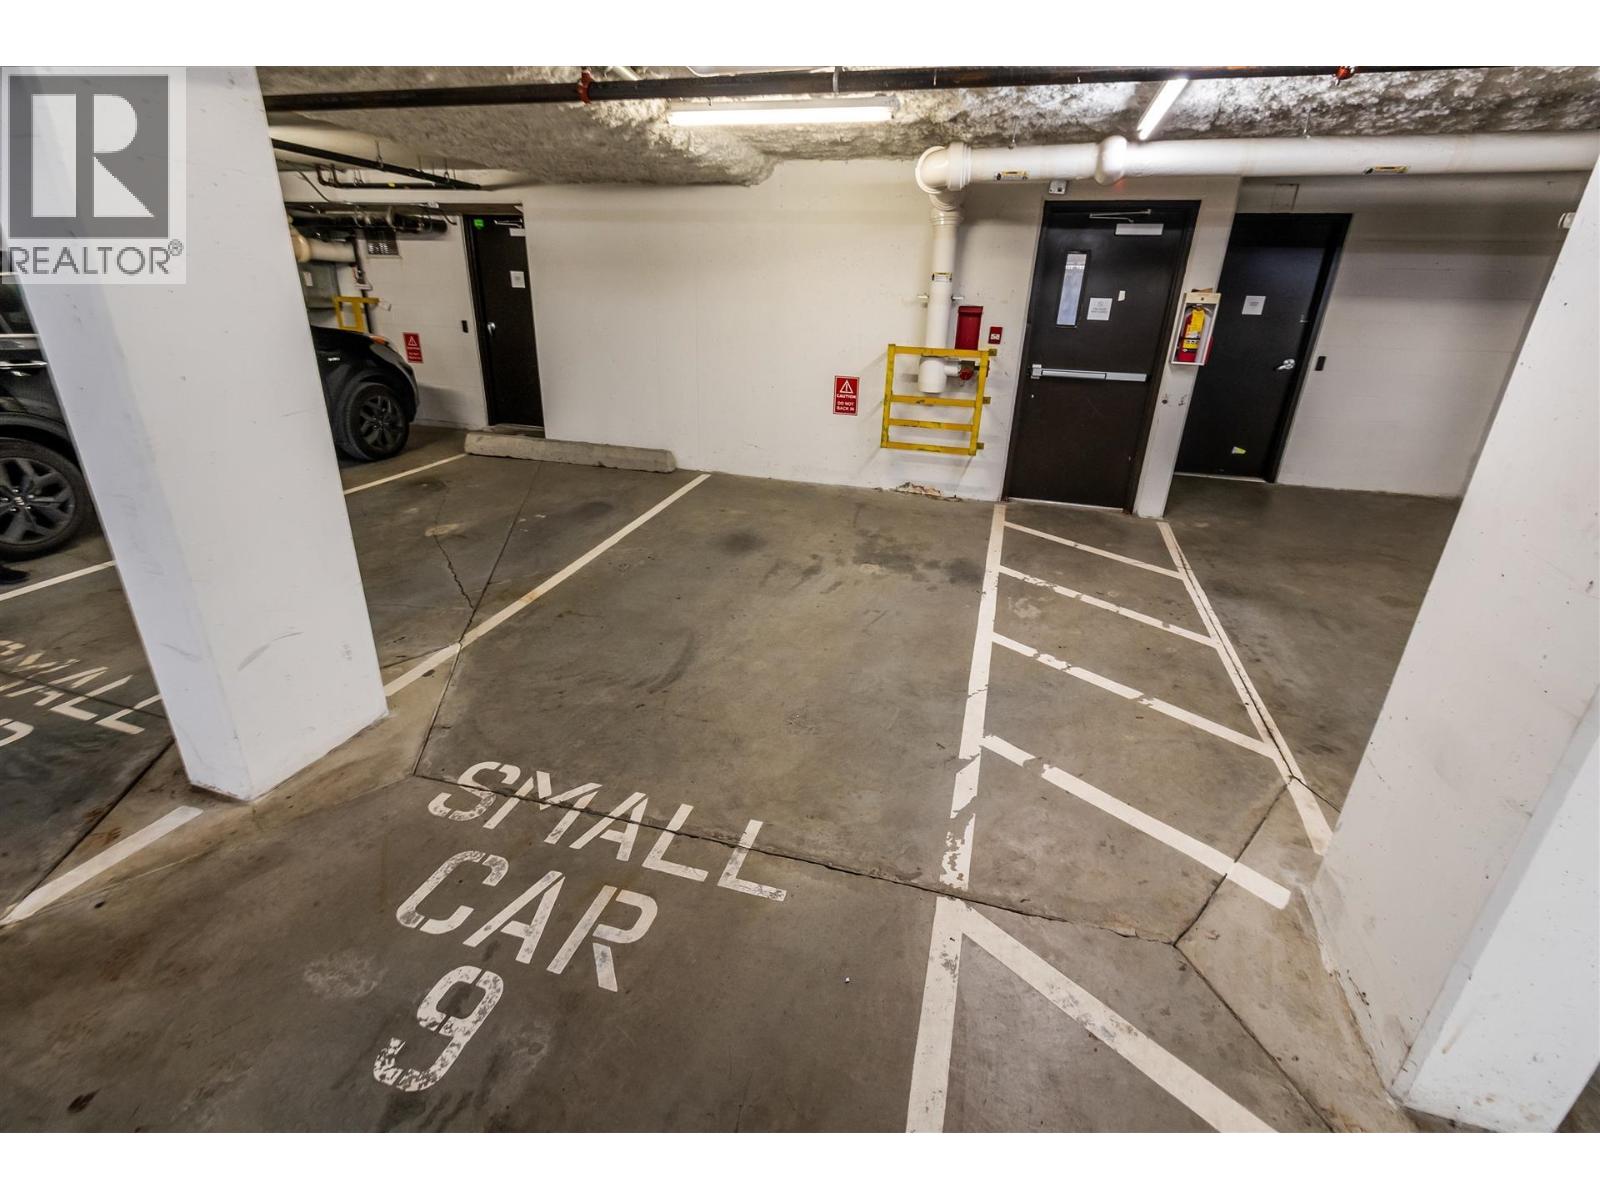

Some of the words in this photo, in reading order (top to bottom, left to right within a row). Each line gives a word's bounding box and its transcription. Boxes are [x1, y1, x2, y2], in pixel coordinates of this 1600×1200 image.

[428, 761, 788, 902] SMALL
[396, 850, 659, 993] CAR
[373, 965, 504, 1093] 9
